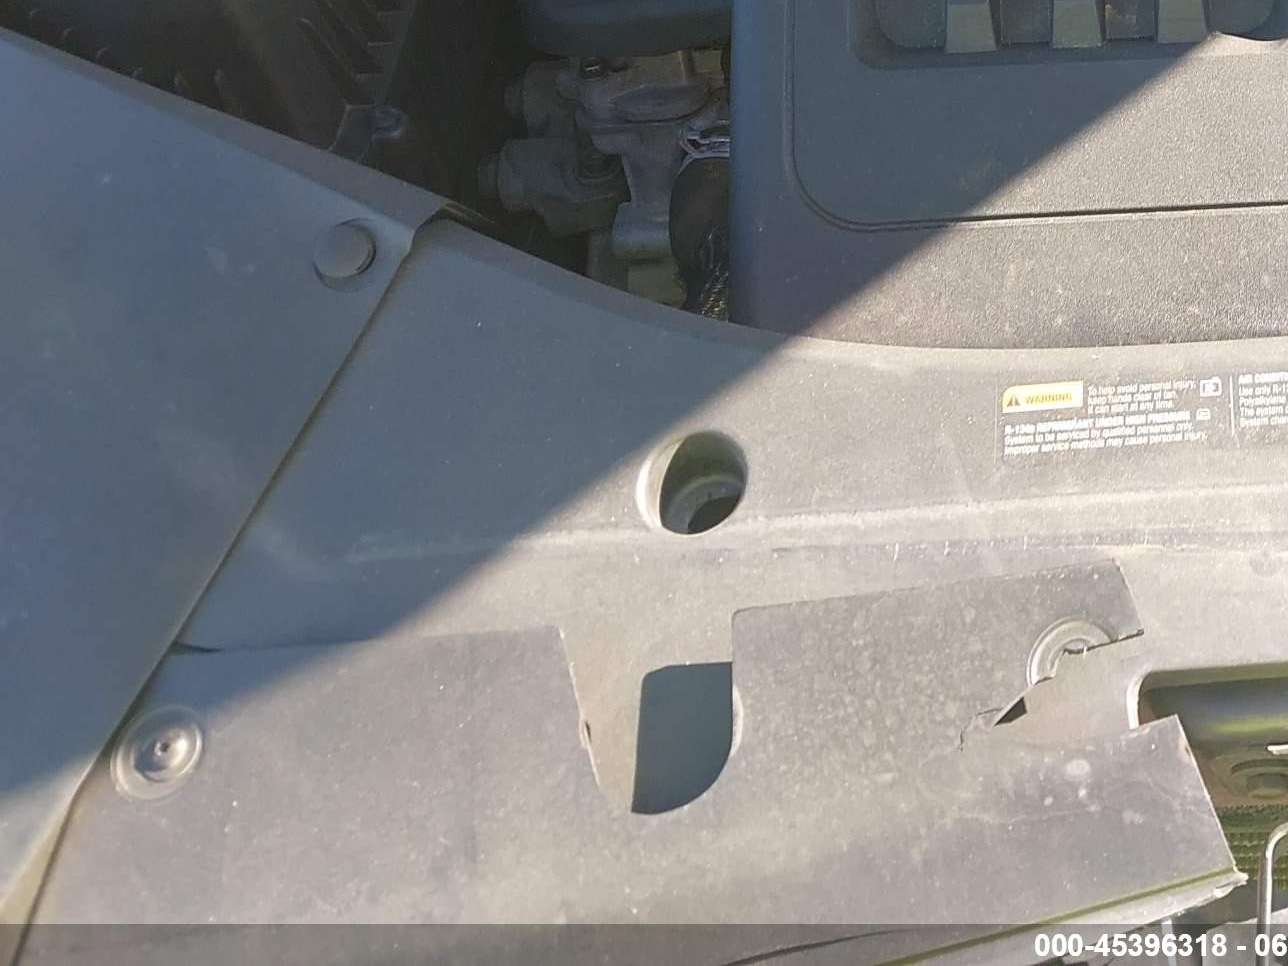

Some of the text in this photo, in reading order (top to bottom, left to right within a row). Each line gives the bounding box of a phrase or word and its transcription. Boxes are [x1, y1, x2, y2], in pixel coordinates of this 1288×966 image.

[1117, 383, 1137, 394] avoid
[1255, 384, 1271, 396] only
[1024, 393, 1072, 405] WARNING
[1133, 392, 1152, 402] clear
[1091, 428, 1102, 440] by
[1106, 437, 1123, 448] may
